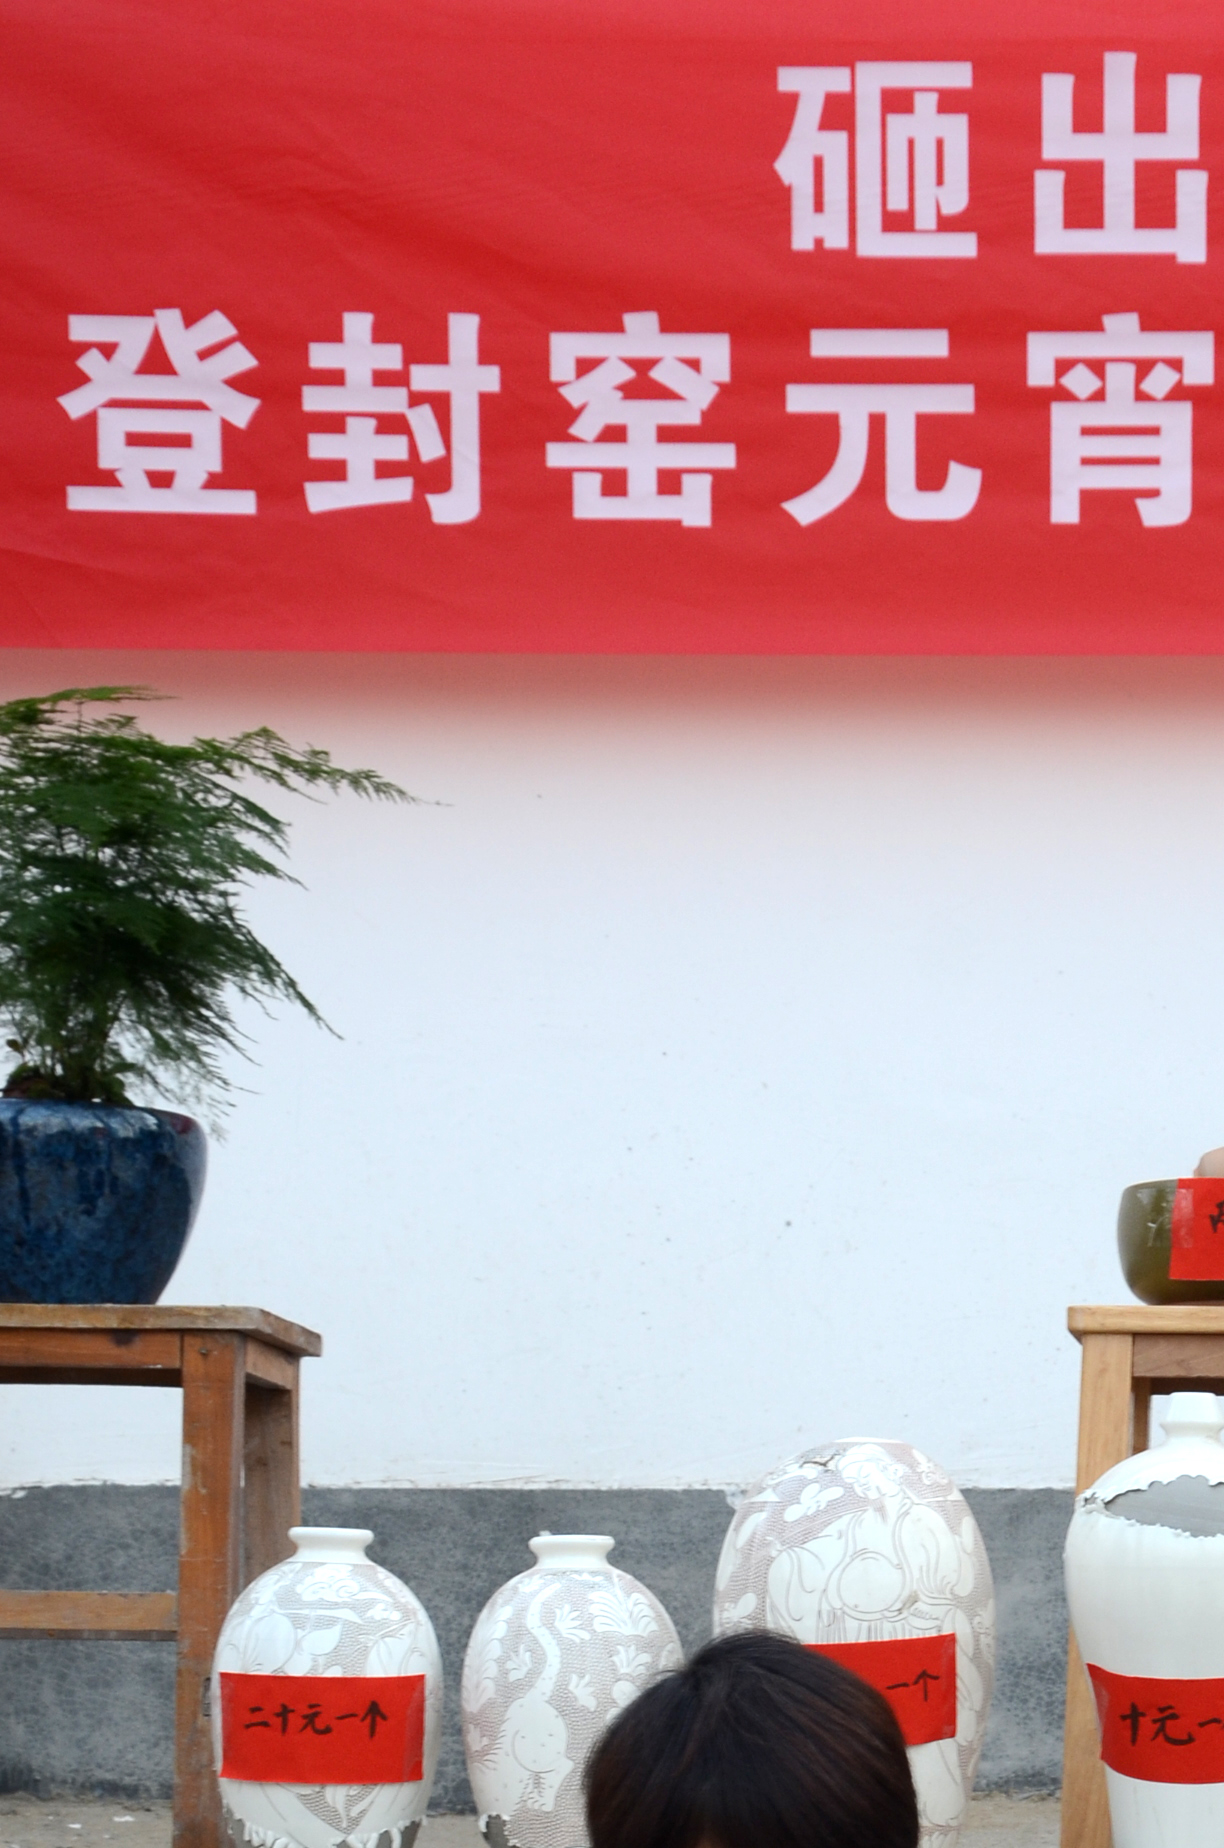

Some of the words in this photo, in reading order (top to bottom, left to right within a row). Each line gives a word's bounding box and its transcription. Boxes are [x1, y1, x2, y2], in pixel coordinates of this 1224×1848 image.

[243, 1700, 389, 1739] 二十元一个
